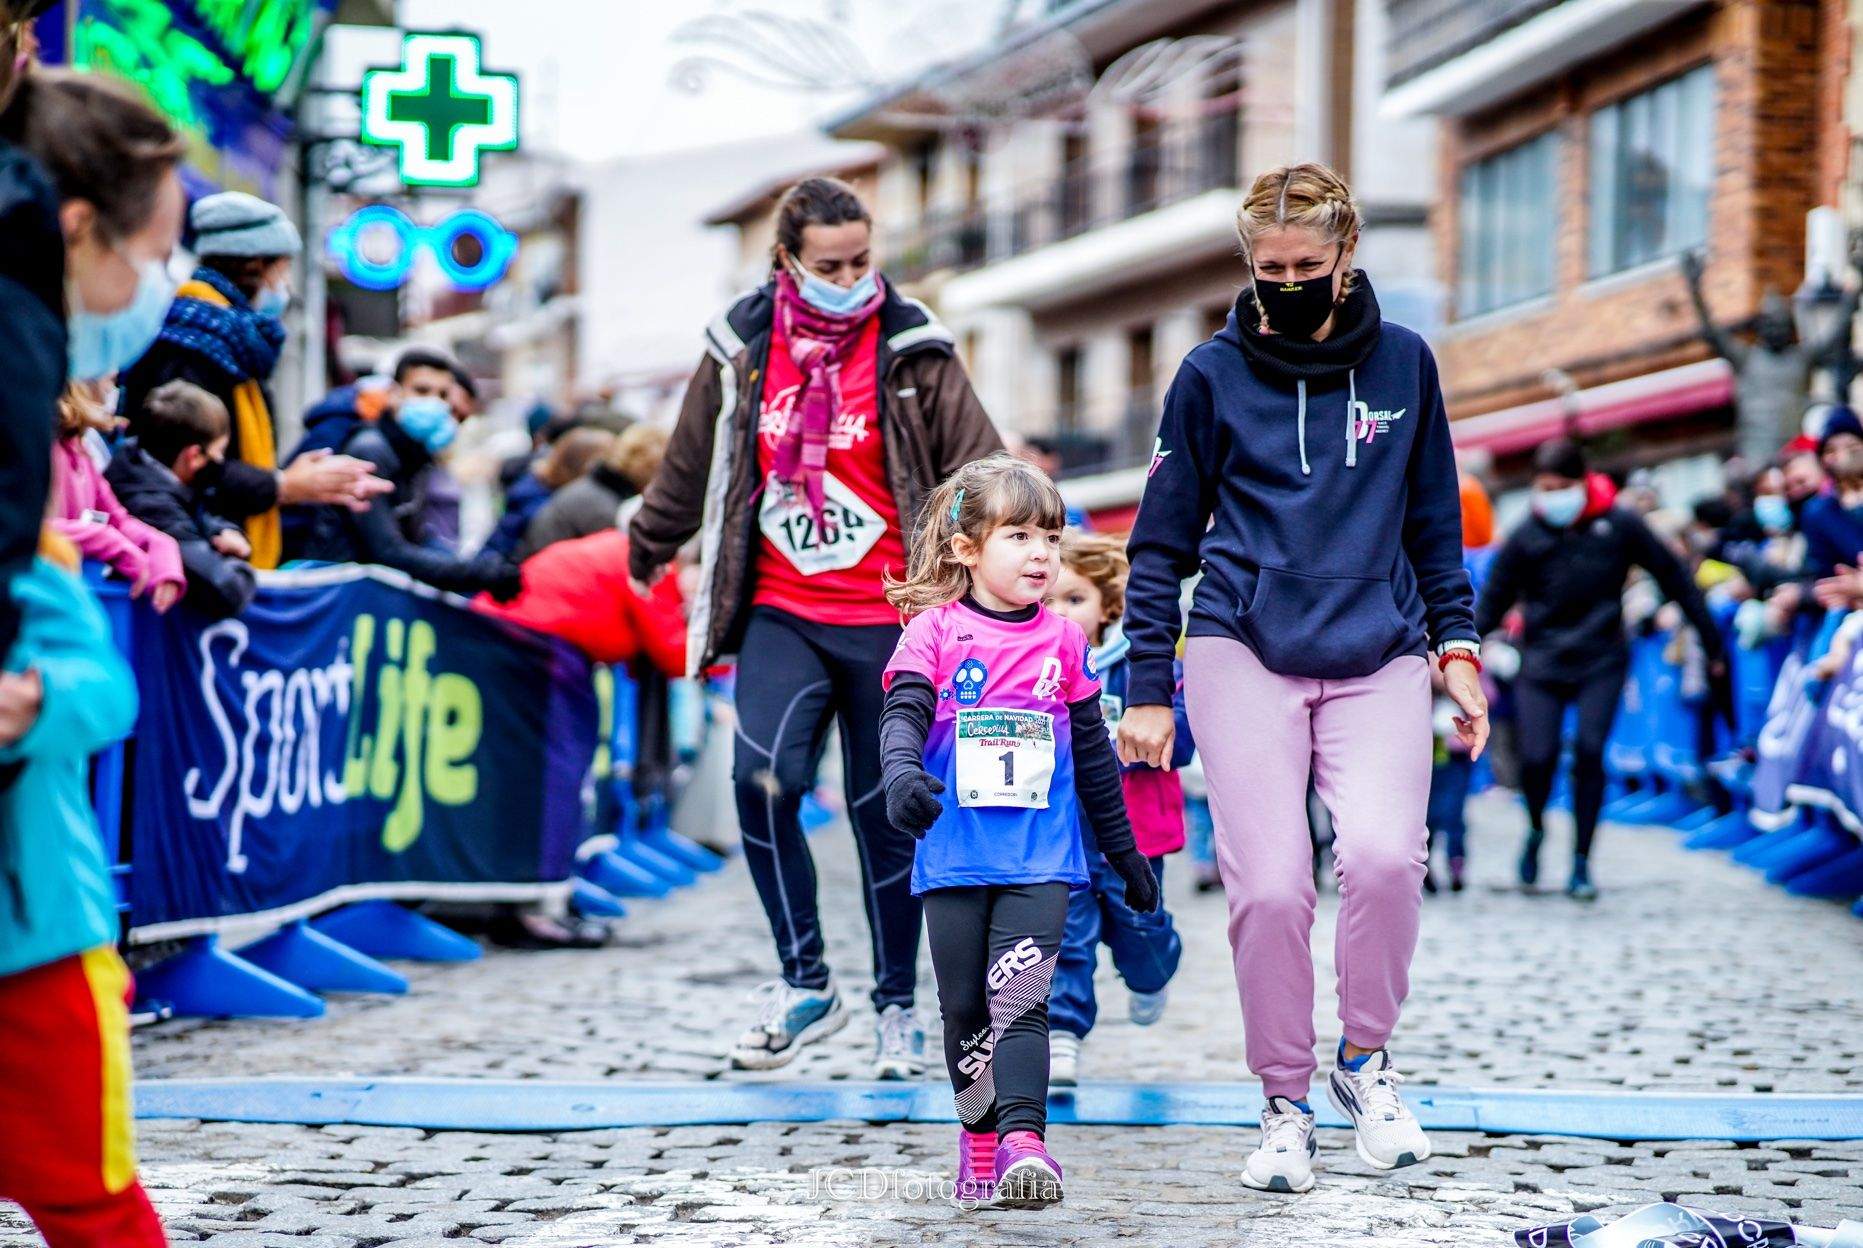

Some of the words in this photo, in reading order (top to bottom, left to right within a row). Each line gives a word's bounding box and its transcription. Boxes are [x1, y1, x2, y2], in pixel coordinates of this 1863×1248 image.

[1004, 714, 1033, 723] NAVIDAD
[978, 738, 999, 747] Trail
[998, 751, 1014, 786] 1
[988, 937, 1042, 990] ERS
